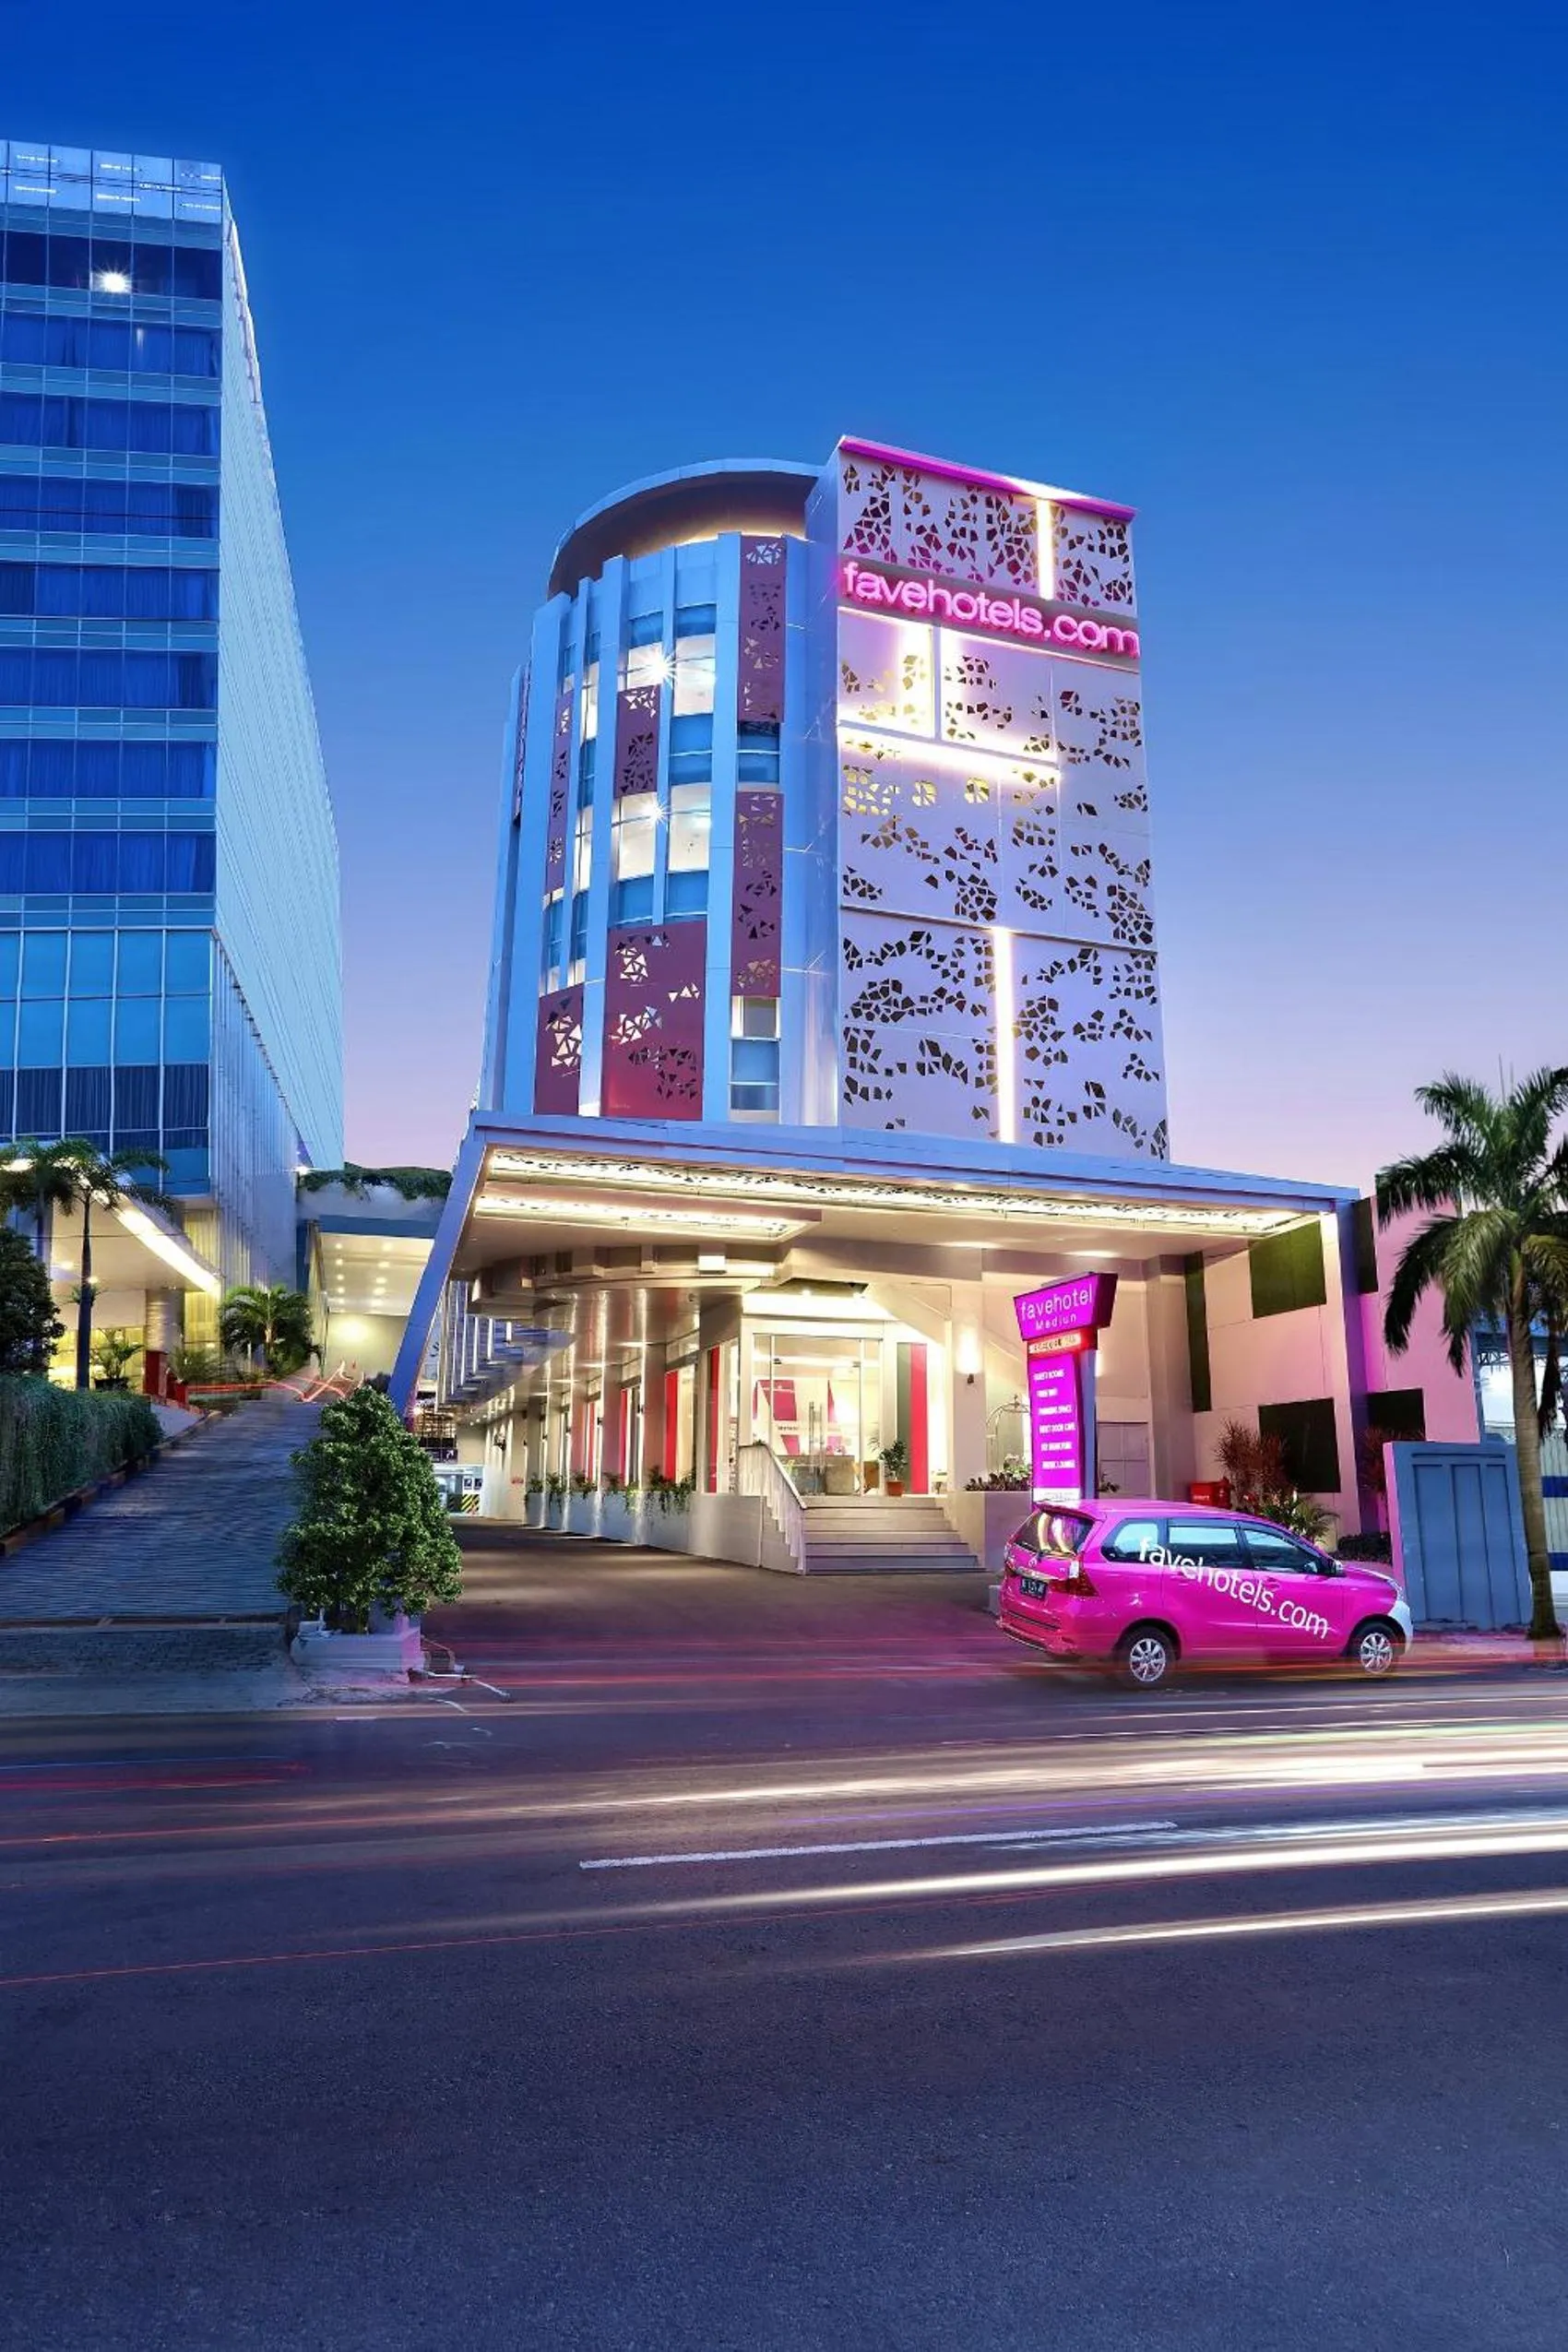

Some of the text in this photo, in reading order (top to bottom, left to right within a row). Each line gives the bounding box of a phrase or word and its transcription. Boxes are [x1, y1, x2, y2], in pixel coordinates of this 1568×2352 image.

[843, 562, 1139, 658] favehotels.com
[1021, 1283, 1093, 1321] favehotel
[1137, 1536, 1329, 1639] favehotels.com
